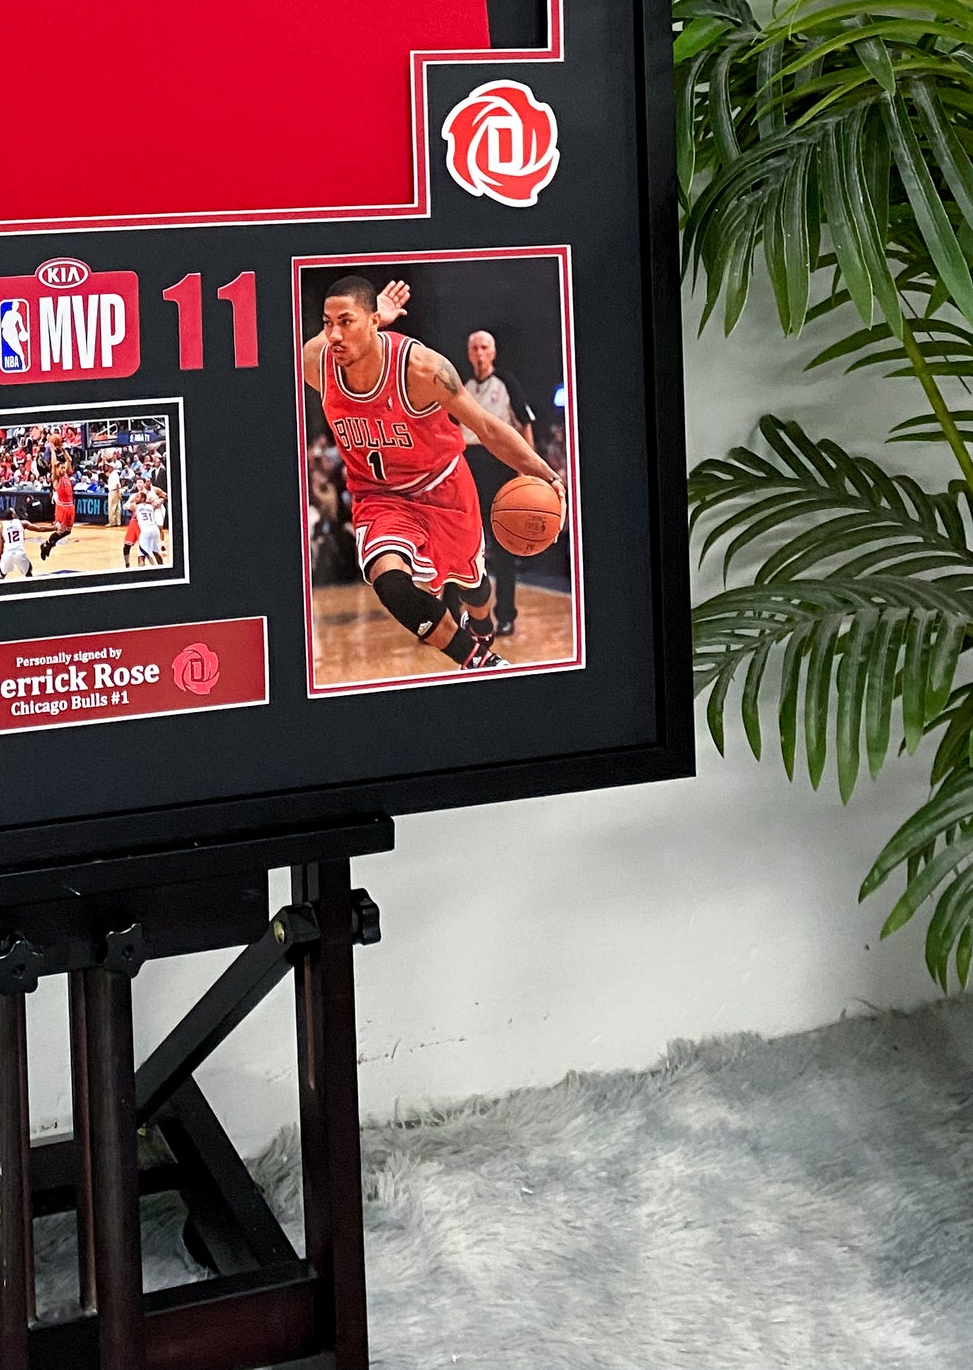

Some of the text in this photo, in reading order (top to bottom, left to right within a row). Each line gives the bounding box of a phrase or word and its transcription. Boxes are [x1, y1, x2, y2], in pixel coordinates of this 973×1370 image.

[47, 267, 80, 283] KIA
[39, 294, 125, 372] MVP
[162, 271, 258, 371] 11
[4, 356, 19, 368] NBA
[333, 417, 414, 451] BULLS
[367, 450, 387, 481] 1
[141, 512, 153, 522] 31
[7, 530, 20, 544] 12
[16, 647, 123, 668] Personally signed by
[93, 663, 160, 688] Rose
[10, 691, 129, 717] Chicago Bulls #1
